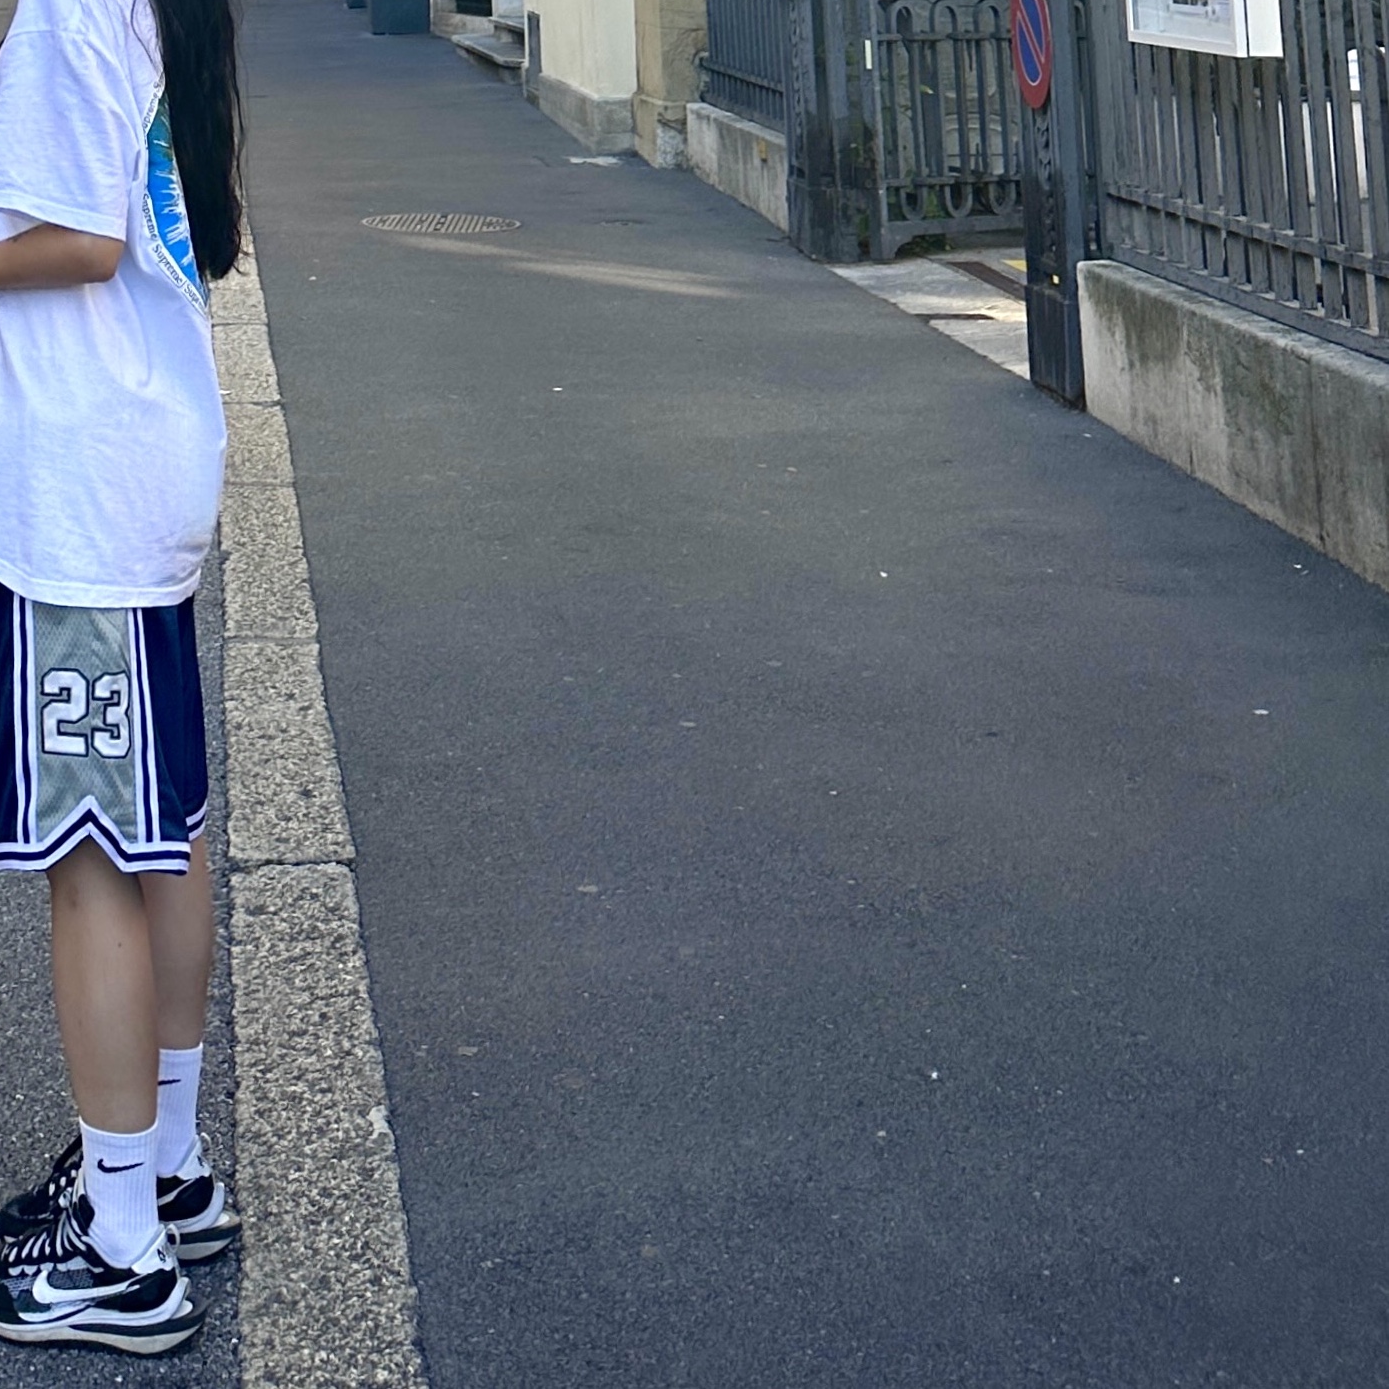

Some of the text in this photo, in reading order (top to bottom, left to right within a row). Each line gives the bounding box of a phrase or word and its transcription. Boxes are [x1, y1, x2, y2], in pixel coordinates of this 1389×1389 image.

[142, 92, 160, 134] upreme
[152, 243, 184, 285] Supreme
[40, 667, 132, 759] 23
